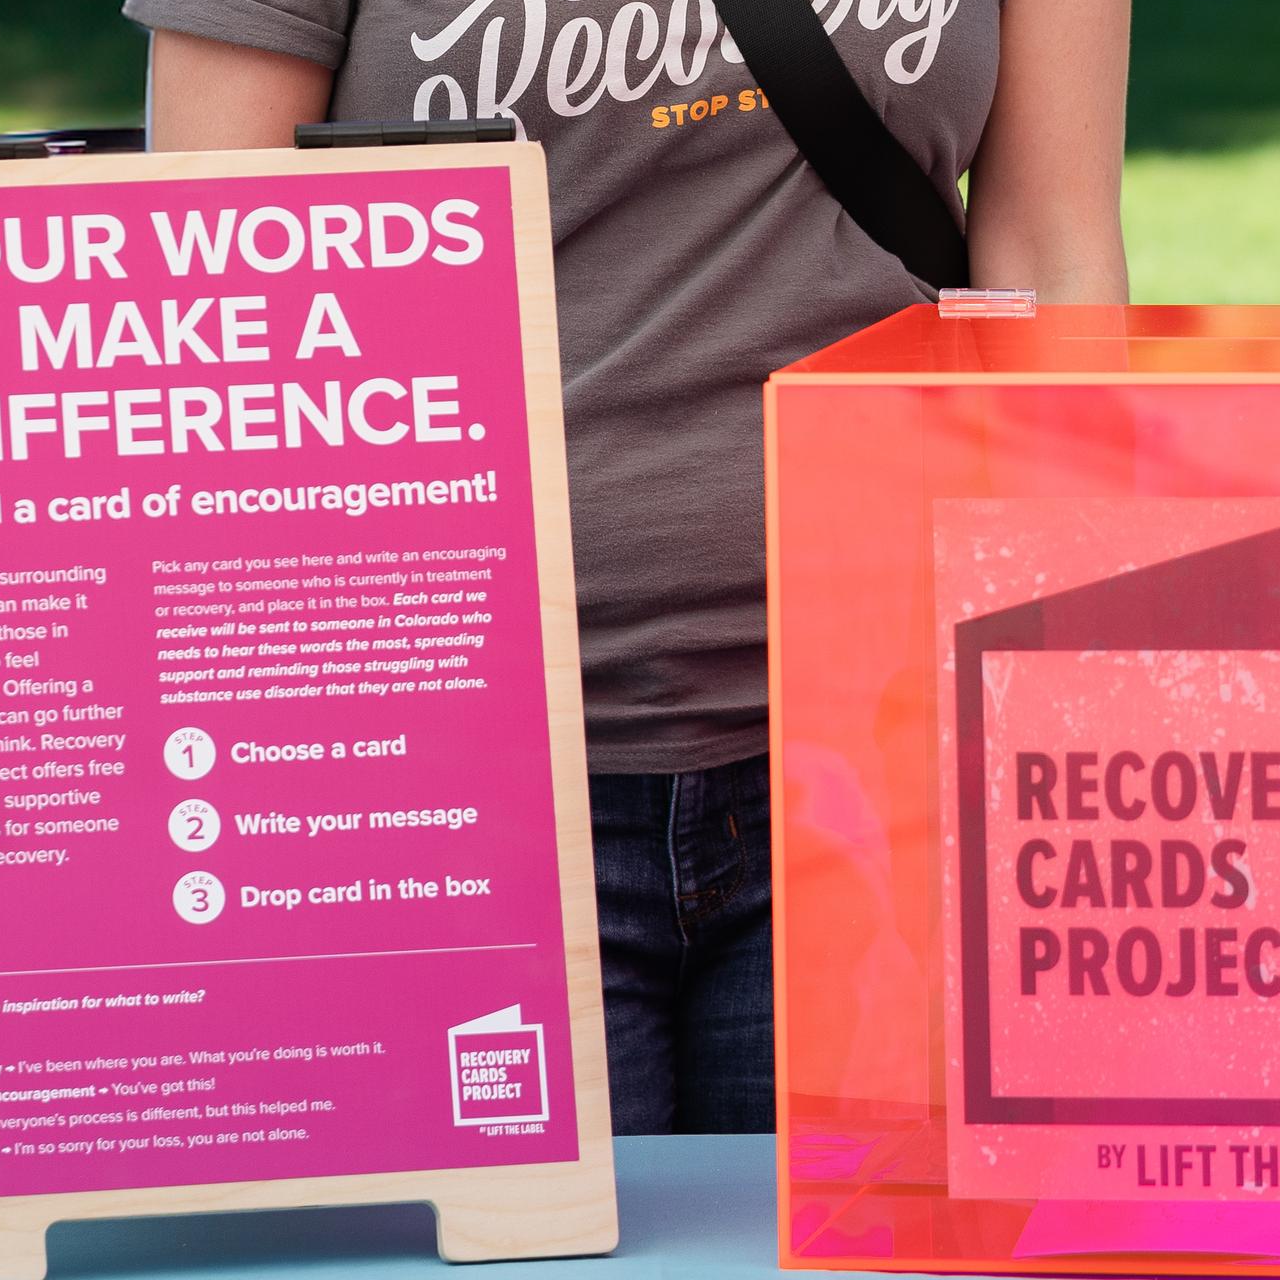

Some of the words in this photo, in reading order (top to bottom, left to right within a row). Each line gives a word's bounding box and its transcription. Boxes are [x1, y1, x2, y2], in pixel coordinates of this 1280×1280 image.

[651, 94, 730, 129] STOP
[150, 198, 484, 276] WORDS
[18, 295, 270, 371] MAKE
[295, 292, 362, 360] A
[13, 498, 36, 524] a
[47, 487, 131, 522] card
[142, 484, 181, 518] of
[190, 470, 497, 516] encouragement!
[21, 594, 71, 612] make
[75, 592, 88, 609] it
[51, 622, 69, 638] in
[4, 650, 40, 669] feel
[2, 678, 78, 698] Offering
[81, 679, 94, 693] a
[33, 709, 58, 727] go
[61, 703, 124, 722] further
[40, 733, 126, 751] Recovery
[174, 732, 203, 744] STEP
[182, 744, 194, 768] 1
[230, 741, 325, 764] Choose
[330, 742, 346, 759] a
[352, 733, 406, 757] card
[32, 761, 84, 779] offers
[87, 759, 125, 776] free
[3, 788, 101, 811] supportive
[179, 804, 208, 816] STEP
[4, 819, 30, 836] for
[34, 818, 120, 836] someone
[186, 816, 205, 840] 2
[234, 811, 301, 835] Write
[306, 812, 362, 837] your
[368, 807, 478, 830] message
[183, 876, 213, 889] STEP
[1016, 838, 1250, 910] CARDS
[191, 888, 209, 912] 3
[240, 886, 302, 910] Drop
[308, 880, 362, 904] card
[368, 878, 392, 900] in
[397, 877, 439, 899] the
[445, 875, 491, 896] box
[2, 996, 79, 1014] inspiration
[81, 995, 103, 1009] for
[104, 993, 142, 1007] what
[144, 993, 160, 1006] to
[162, 989, 206, 1004] write?
[460, 1048, 531, 1067] RECOVERY
[461, 1067, 507, 1083] CARDS
[111, 1081, 158, 1095] You've
[160, 1080, 185, 1096] got
[186, 1077, 215, 1091] this!
[462, 1082, 522, 1101] PROJECT
[487, 1125, 503, 1136] LIFT
[505, 1124, 520, 1134] THE
[521, 1123, 545, 1134] LABEL
[1097, 1144, 1127, 1169] BY
[1137, 1144, 1217, 1187] LIFT
